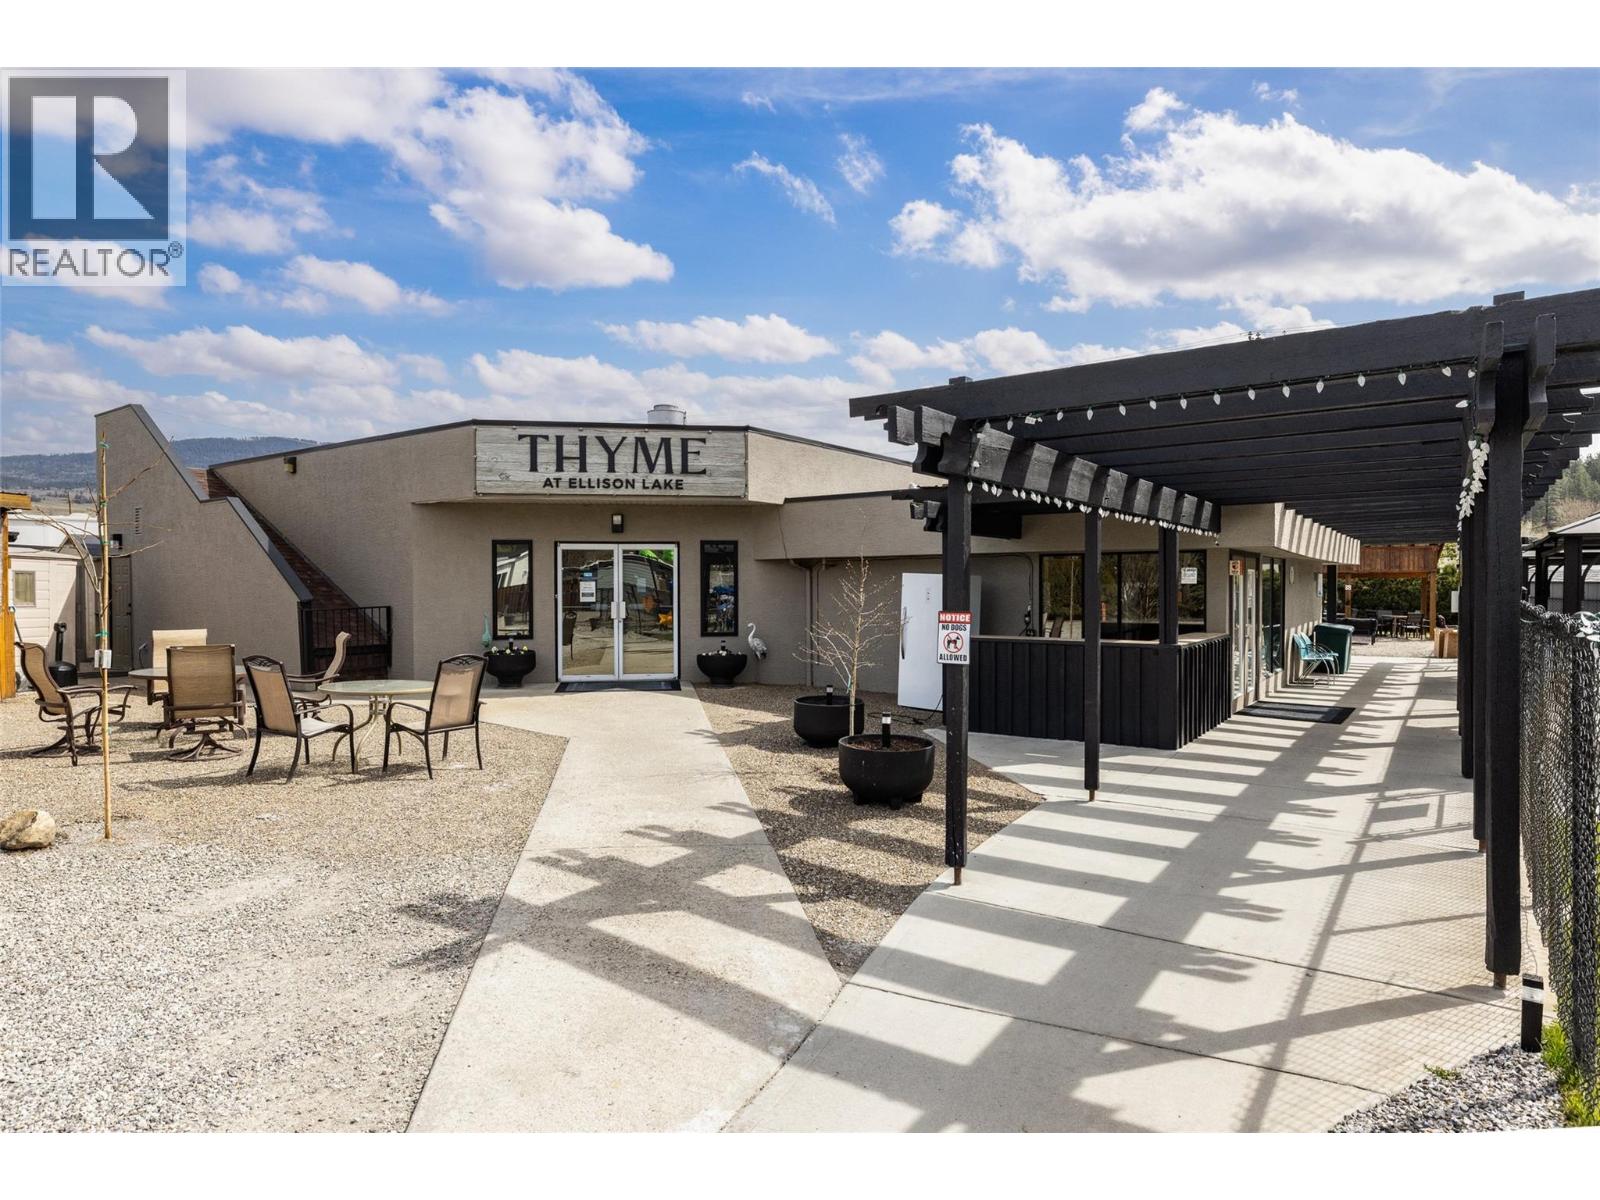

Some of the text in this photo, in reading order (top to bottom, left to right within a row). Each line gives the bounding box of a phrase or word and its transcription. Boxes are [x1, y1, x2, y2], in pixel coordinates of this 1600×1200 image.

[517, 434, 707, 475] THYME
[542, 477, 684, 490] AT ELLISON LAKE
[939, 613, 971, 622] NOTICE
[939, 653, 967, 661] ALLOWED
